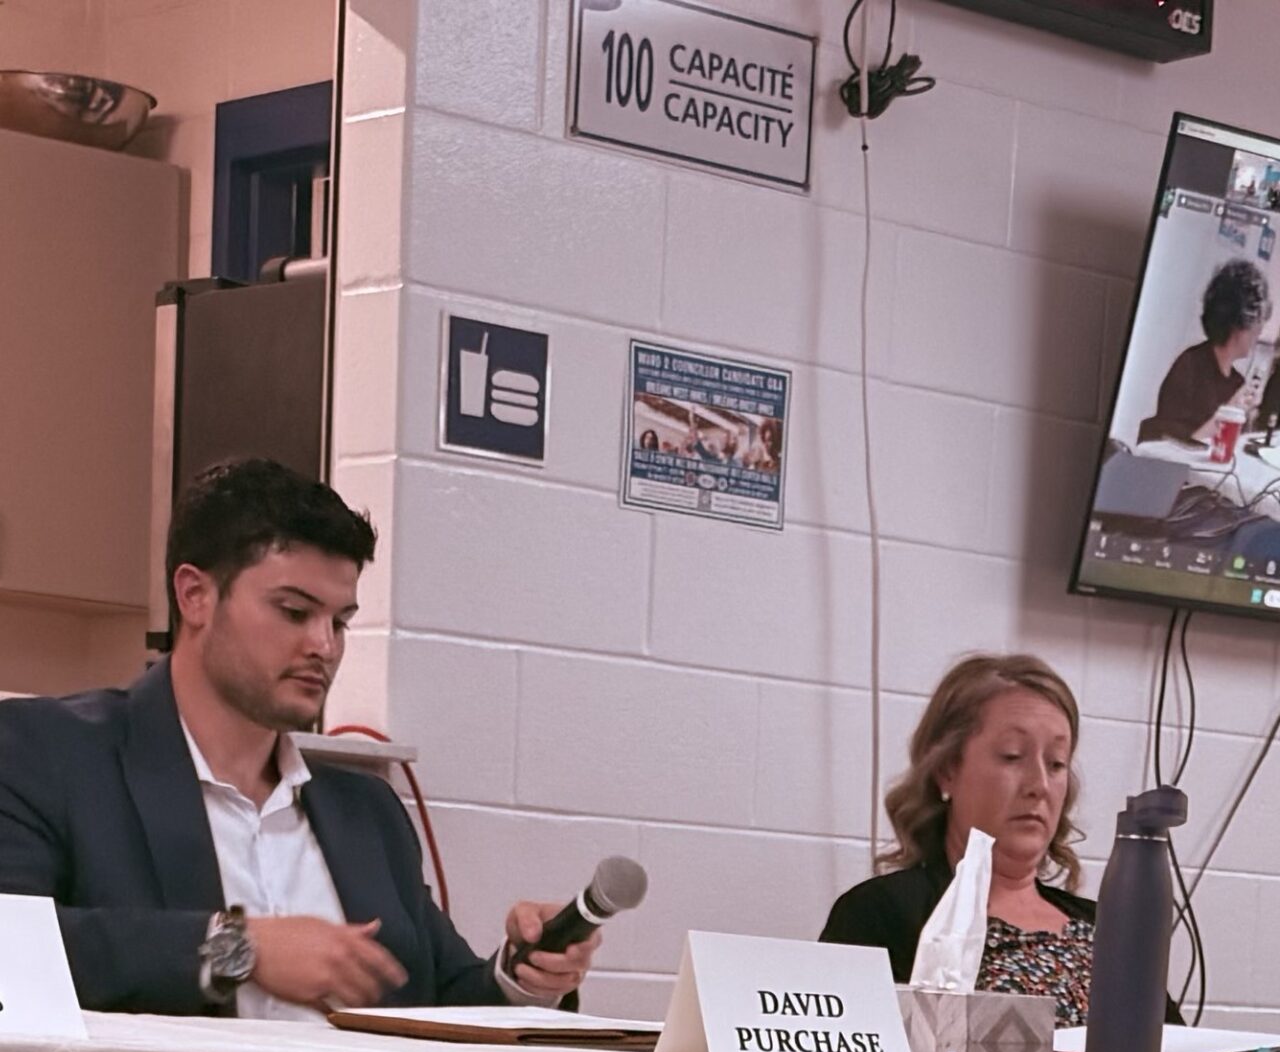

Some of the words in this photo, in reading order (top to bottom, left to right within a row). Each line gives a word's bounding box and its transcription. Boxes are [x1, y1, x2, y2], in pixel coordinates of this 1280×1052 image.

[602, 30, 654, 112] 100
[669, 44, 794, 101] CAPACITÉ
[664, 93, 794, 148] CAPACITY
[757, 990, 844, 1018] DAVID
